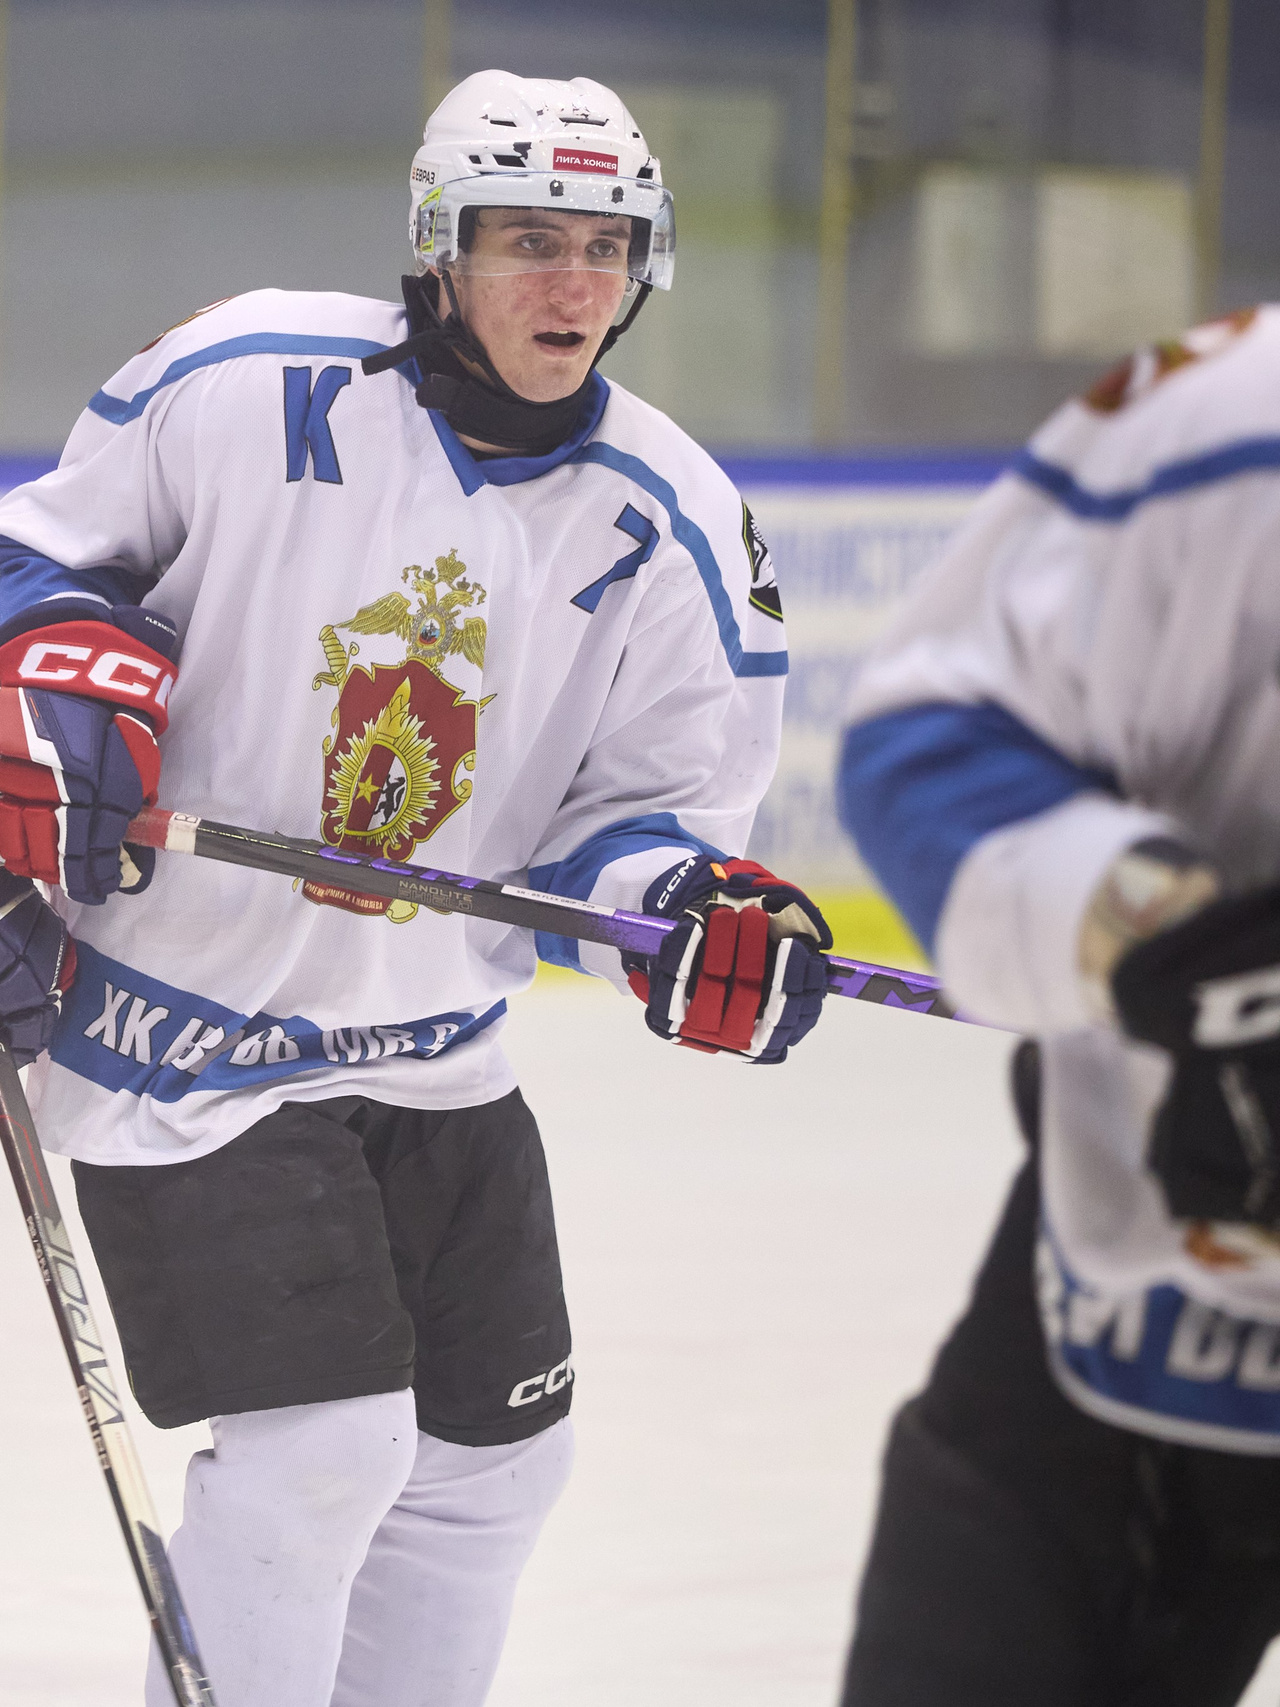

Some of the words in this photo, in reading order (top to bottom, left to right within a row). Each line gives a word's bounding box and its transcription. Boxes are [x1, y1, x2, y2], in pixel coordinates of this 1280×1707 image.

[555, 155, 581, 165] ЛИГА
[582, 158, 617, 171] ХОККЕЯ
[415, 168, 436, 185] ЕВРАЗ
[399, 880, 474, 903] NANOLITE
[656, 857, 697, 910] CCM
[83, 980, 170, 1065] ХК
